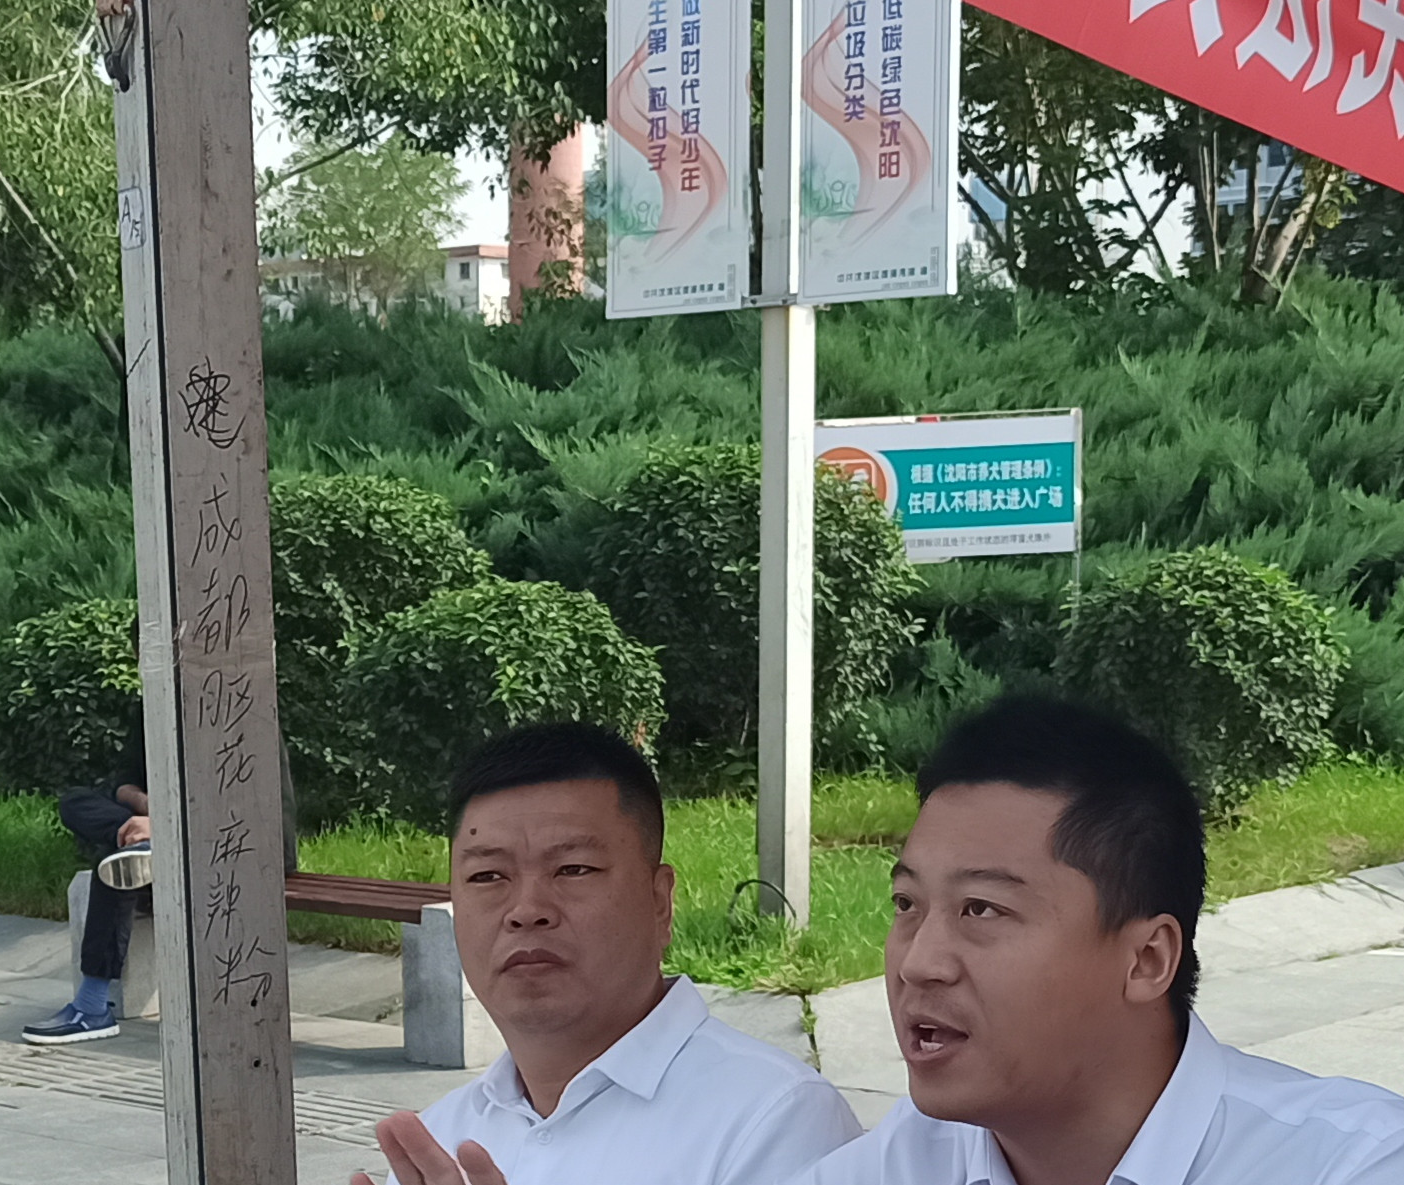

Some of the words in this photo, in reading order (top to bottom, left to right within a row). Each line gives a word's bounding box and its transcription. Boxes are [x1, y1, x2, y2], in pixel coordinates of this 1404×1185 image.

[844, 0, 867, 123] 垃圾分类
[878, 0, 904, 180] 低碳绿色沈阳
[907, 486, 1064, 515] 任何人不得携犬进入广场
